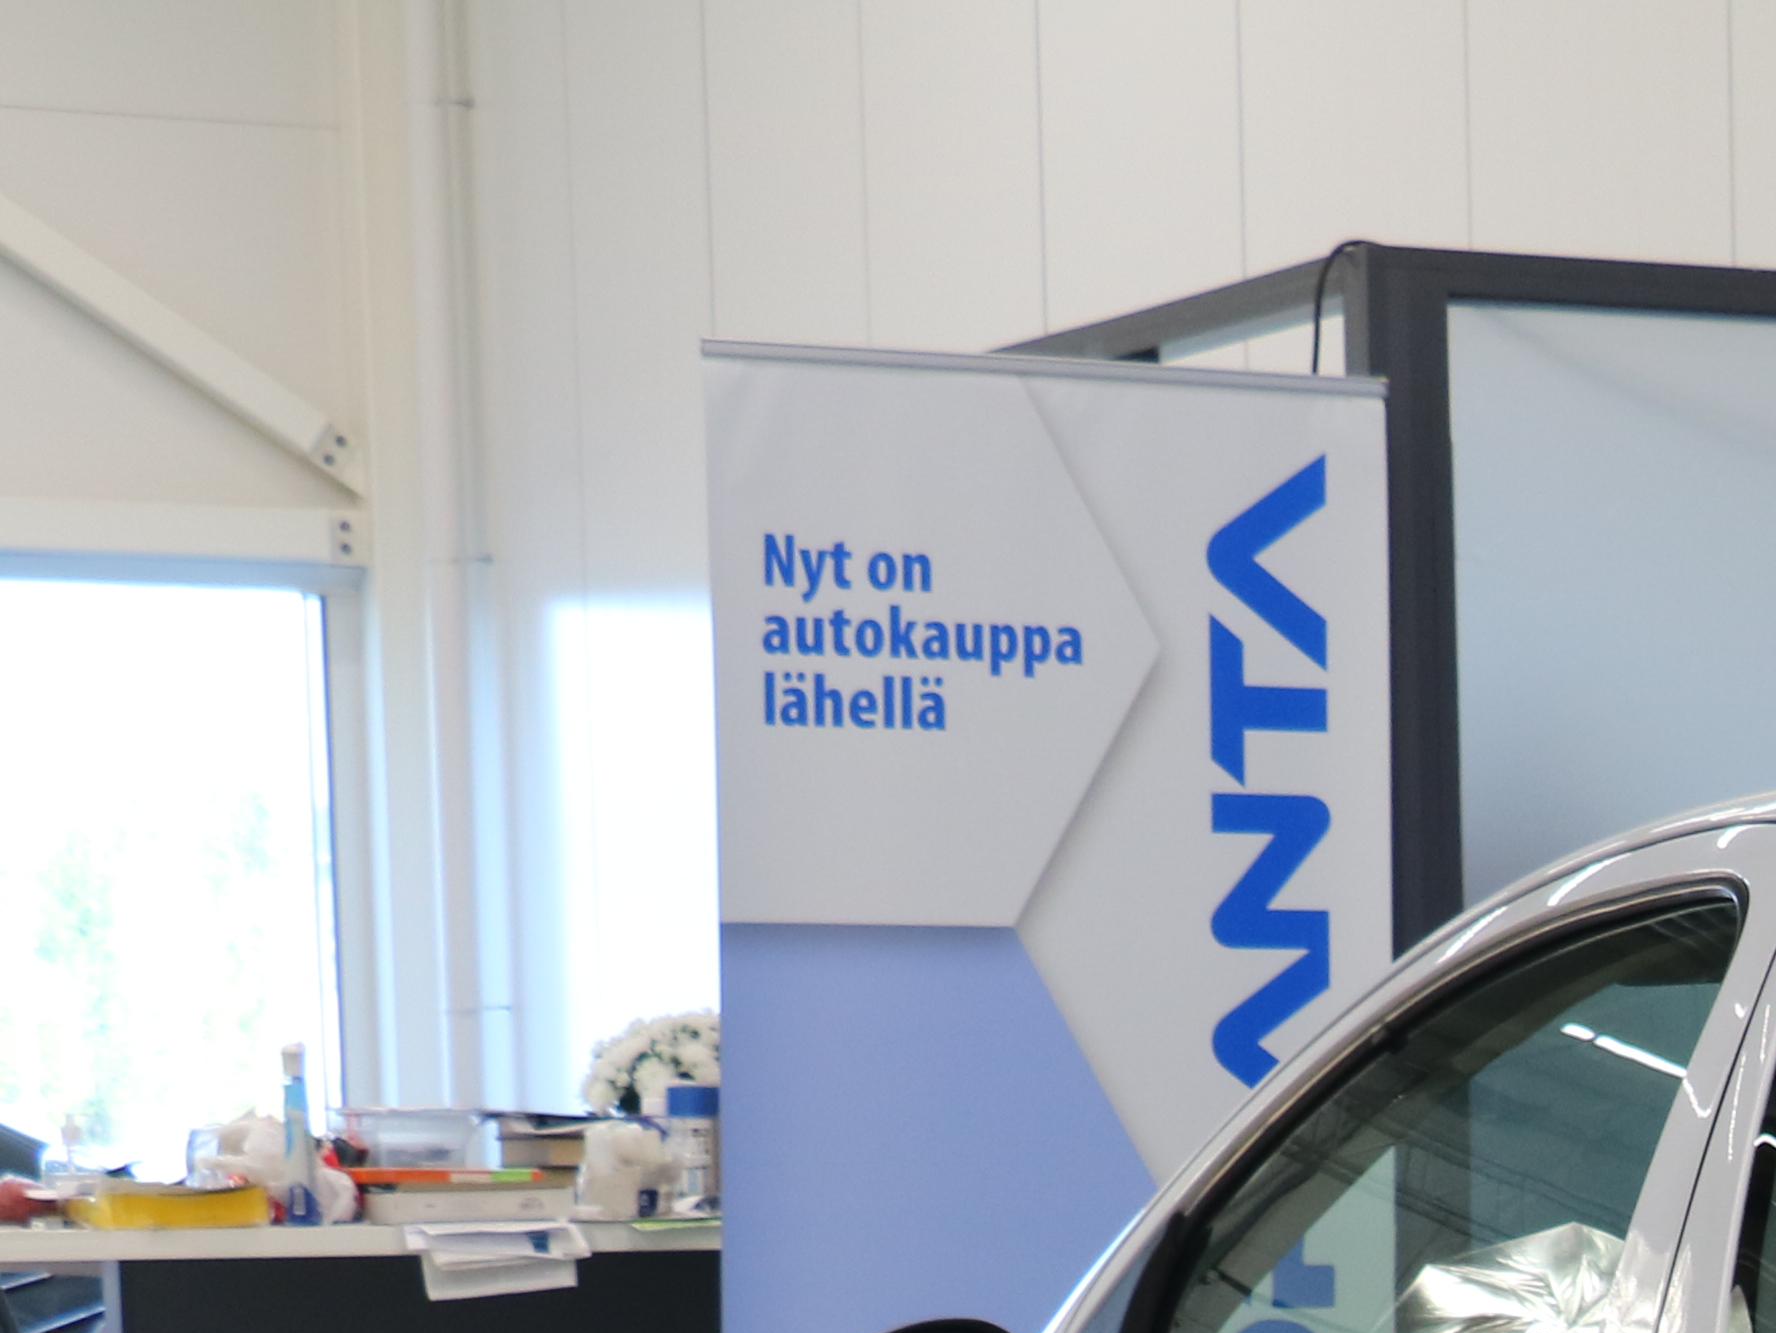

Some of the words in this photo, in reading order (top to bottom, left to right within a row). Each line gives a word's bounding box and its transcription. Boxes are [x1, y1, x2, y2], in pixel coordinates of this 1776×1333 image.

[762, 533, 852, 603] Nyt
[866, 548, 933, 593] on
[761, 604, 1084, 679] autokauppa
[762, 670, 947, 732] lähellä
